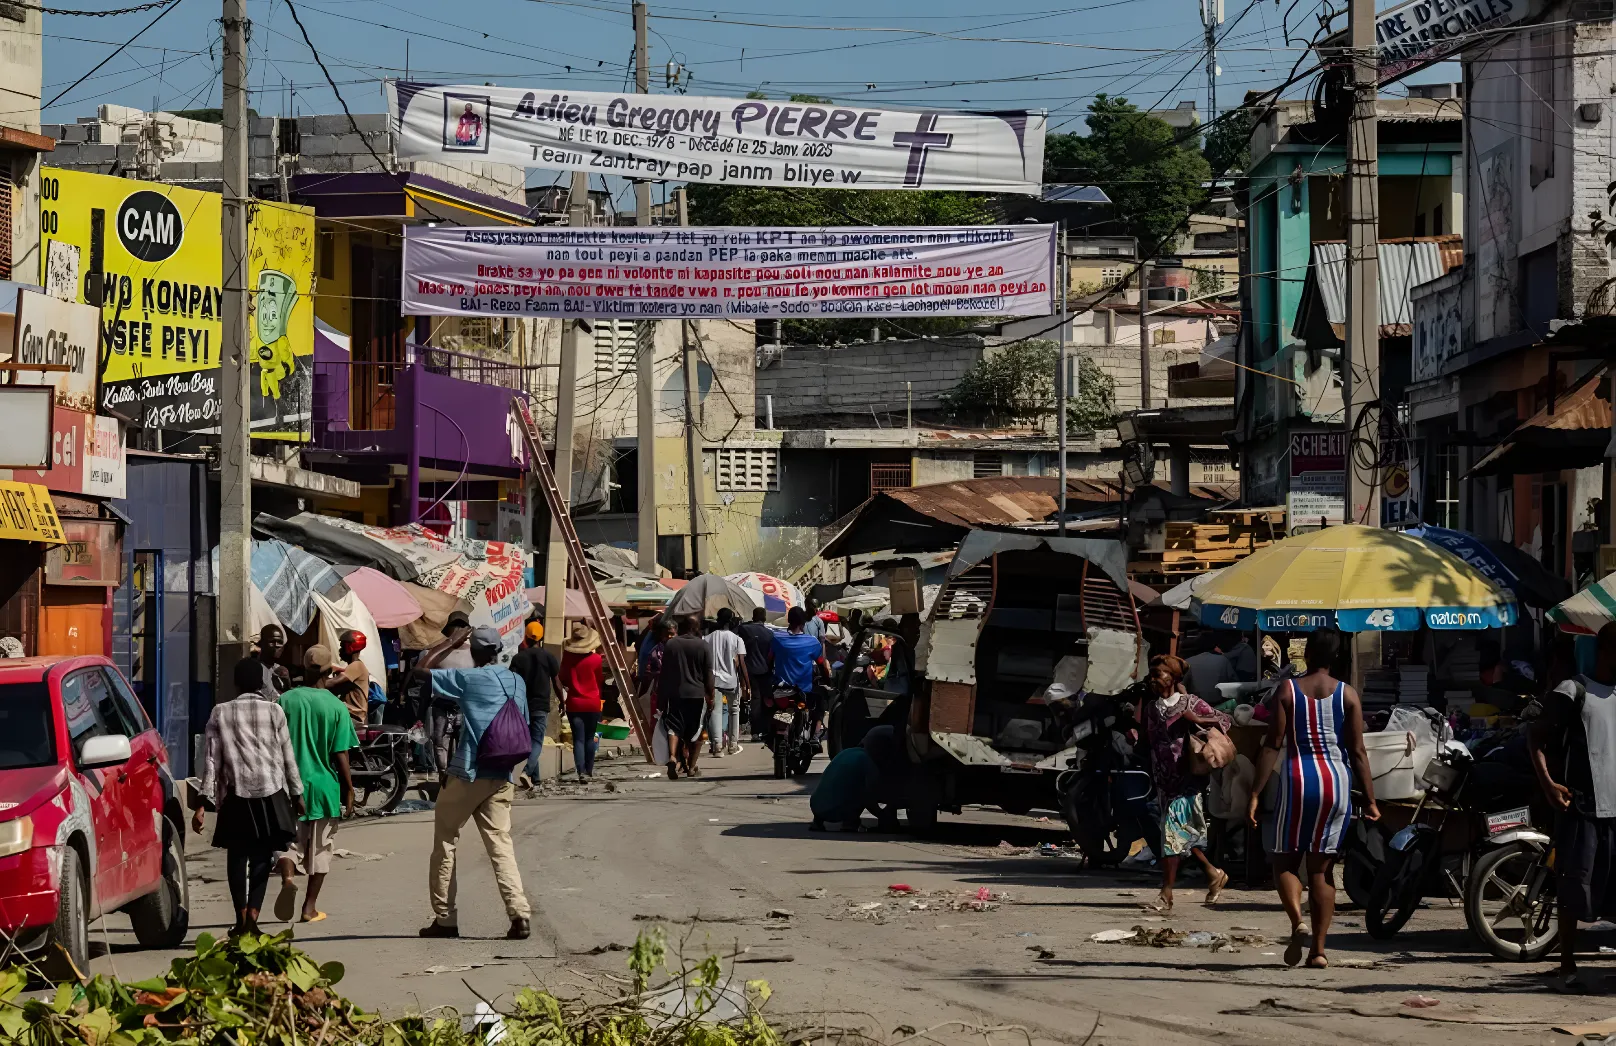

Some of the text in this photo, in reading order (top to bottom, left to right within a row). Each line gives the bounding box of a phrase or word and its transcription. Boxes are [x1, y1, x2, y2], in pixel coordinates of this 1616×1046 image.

[511, 91, 882, 141] Adieu Gregory PIERRE
[558, 125, 575, 141] NÉ
[580, 127, 593, 143] LE
[596, 130, 608, 144] 12
[613, 132, 642, 147] DEC.
[647, 135, 675, 150] 1978
[736, 139, 748, 154] le
[752, 140, 767, 155] 25
[802, 142, 833, 157] 2025
[529, 145, 862, 186] Team Zantray pap janm bliye w
[41, 176, 59, 201] 00
[123, 206, 175, 247] CAM
[756, 230, 797, 245] KPT
[547, 249, 570, 261] nan
[575, 248, 604, 261] tout
[609, 247, 638, 263] peyi
[643, 250, 651, 261] a
[656, 248, 703, 263] pandan
[842, 248, 886, 262] mache
[518, 266, 533, 278] sa
[539, 267, 555, 281] yo
[559, 267, 575, 281] pa
[607, 265, 620, 280] ni
[624, 266, 674, 280] volonte
[162, 325, 209, 364] PEYI
[1220, 606, 1240, 625] 4G
[1267, 613, 1327, 627] natcom
[1365, 609, 1395, 627] 4G
[1430, 611, 1482, 626] natcom
